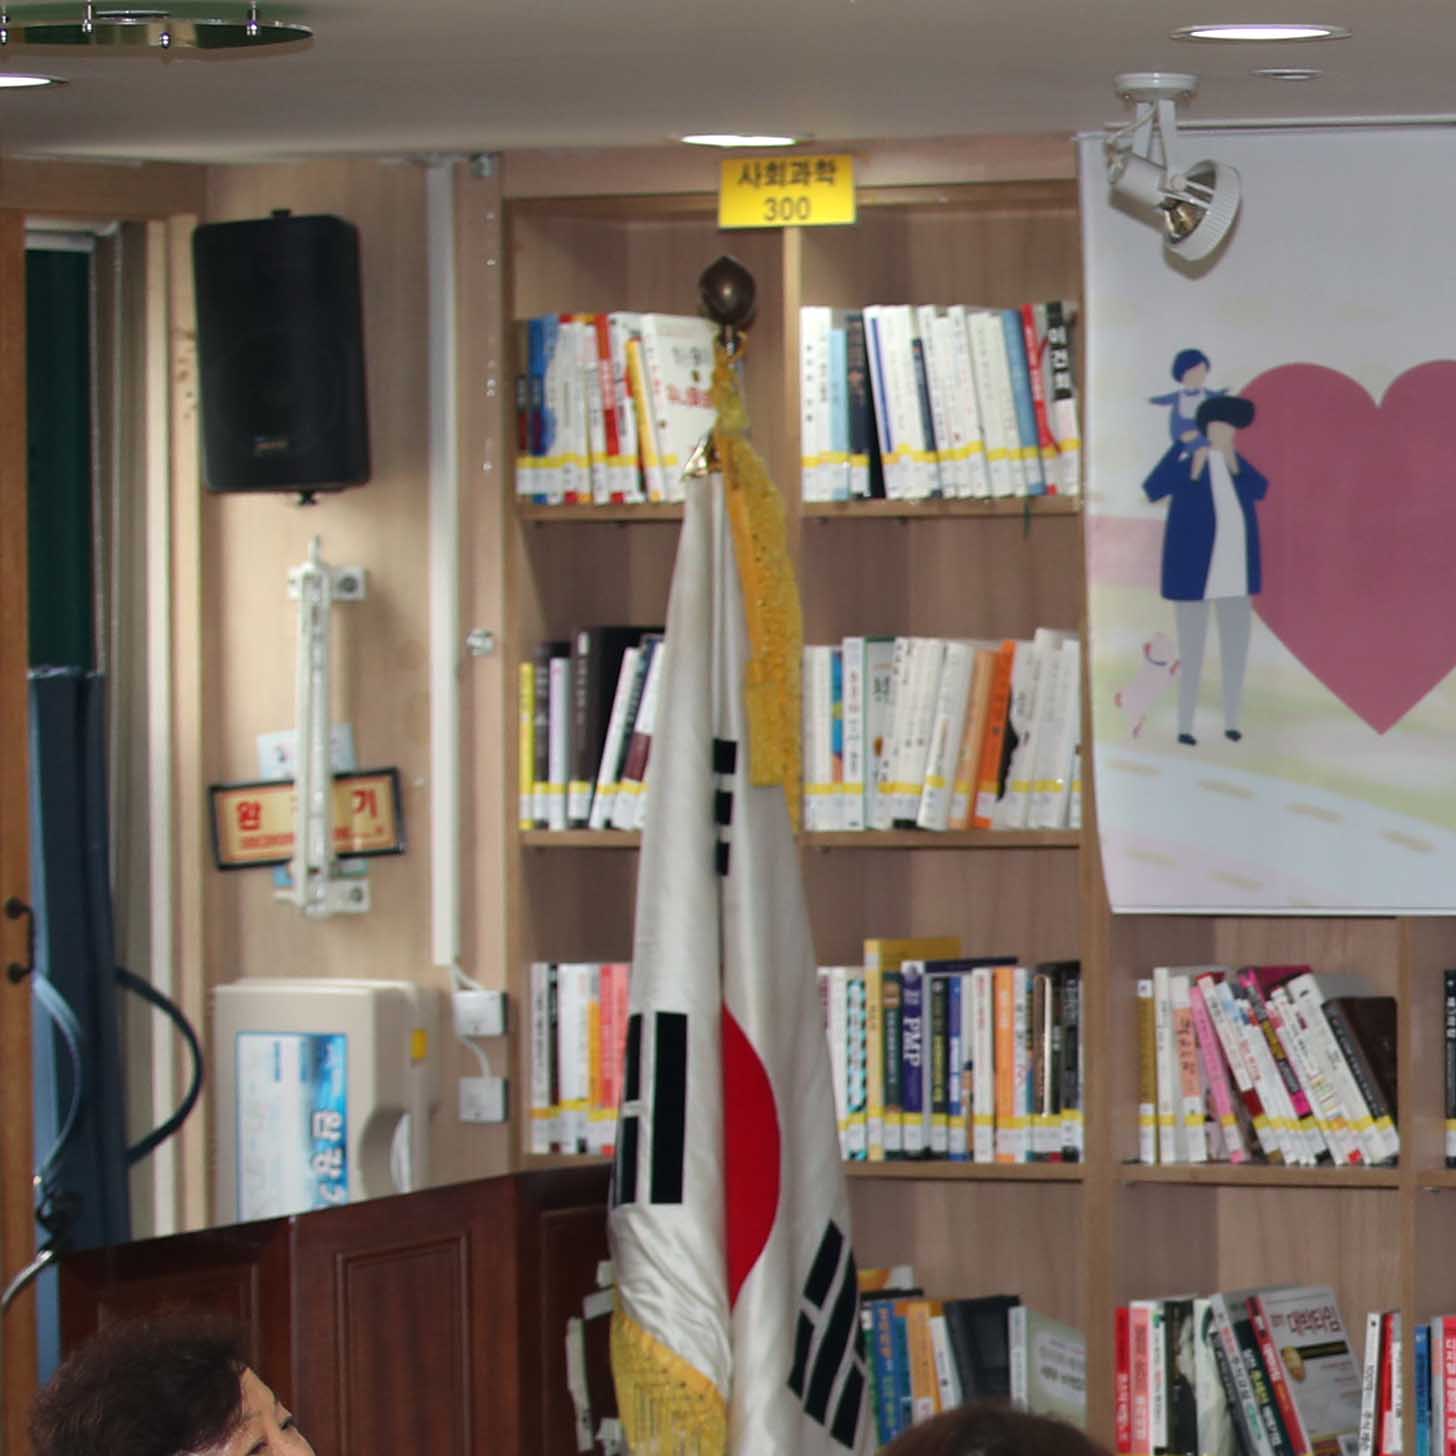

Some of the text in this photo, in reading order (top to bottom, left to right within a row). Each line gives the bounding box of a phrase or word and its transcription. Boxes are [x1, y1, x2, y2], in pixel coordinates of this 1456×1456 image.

[736, 160, 839, 187] 사회과학
[763, 197, 812, 222] 300
[903, 1016, 922, 1068] PMP
